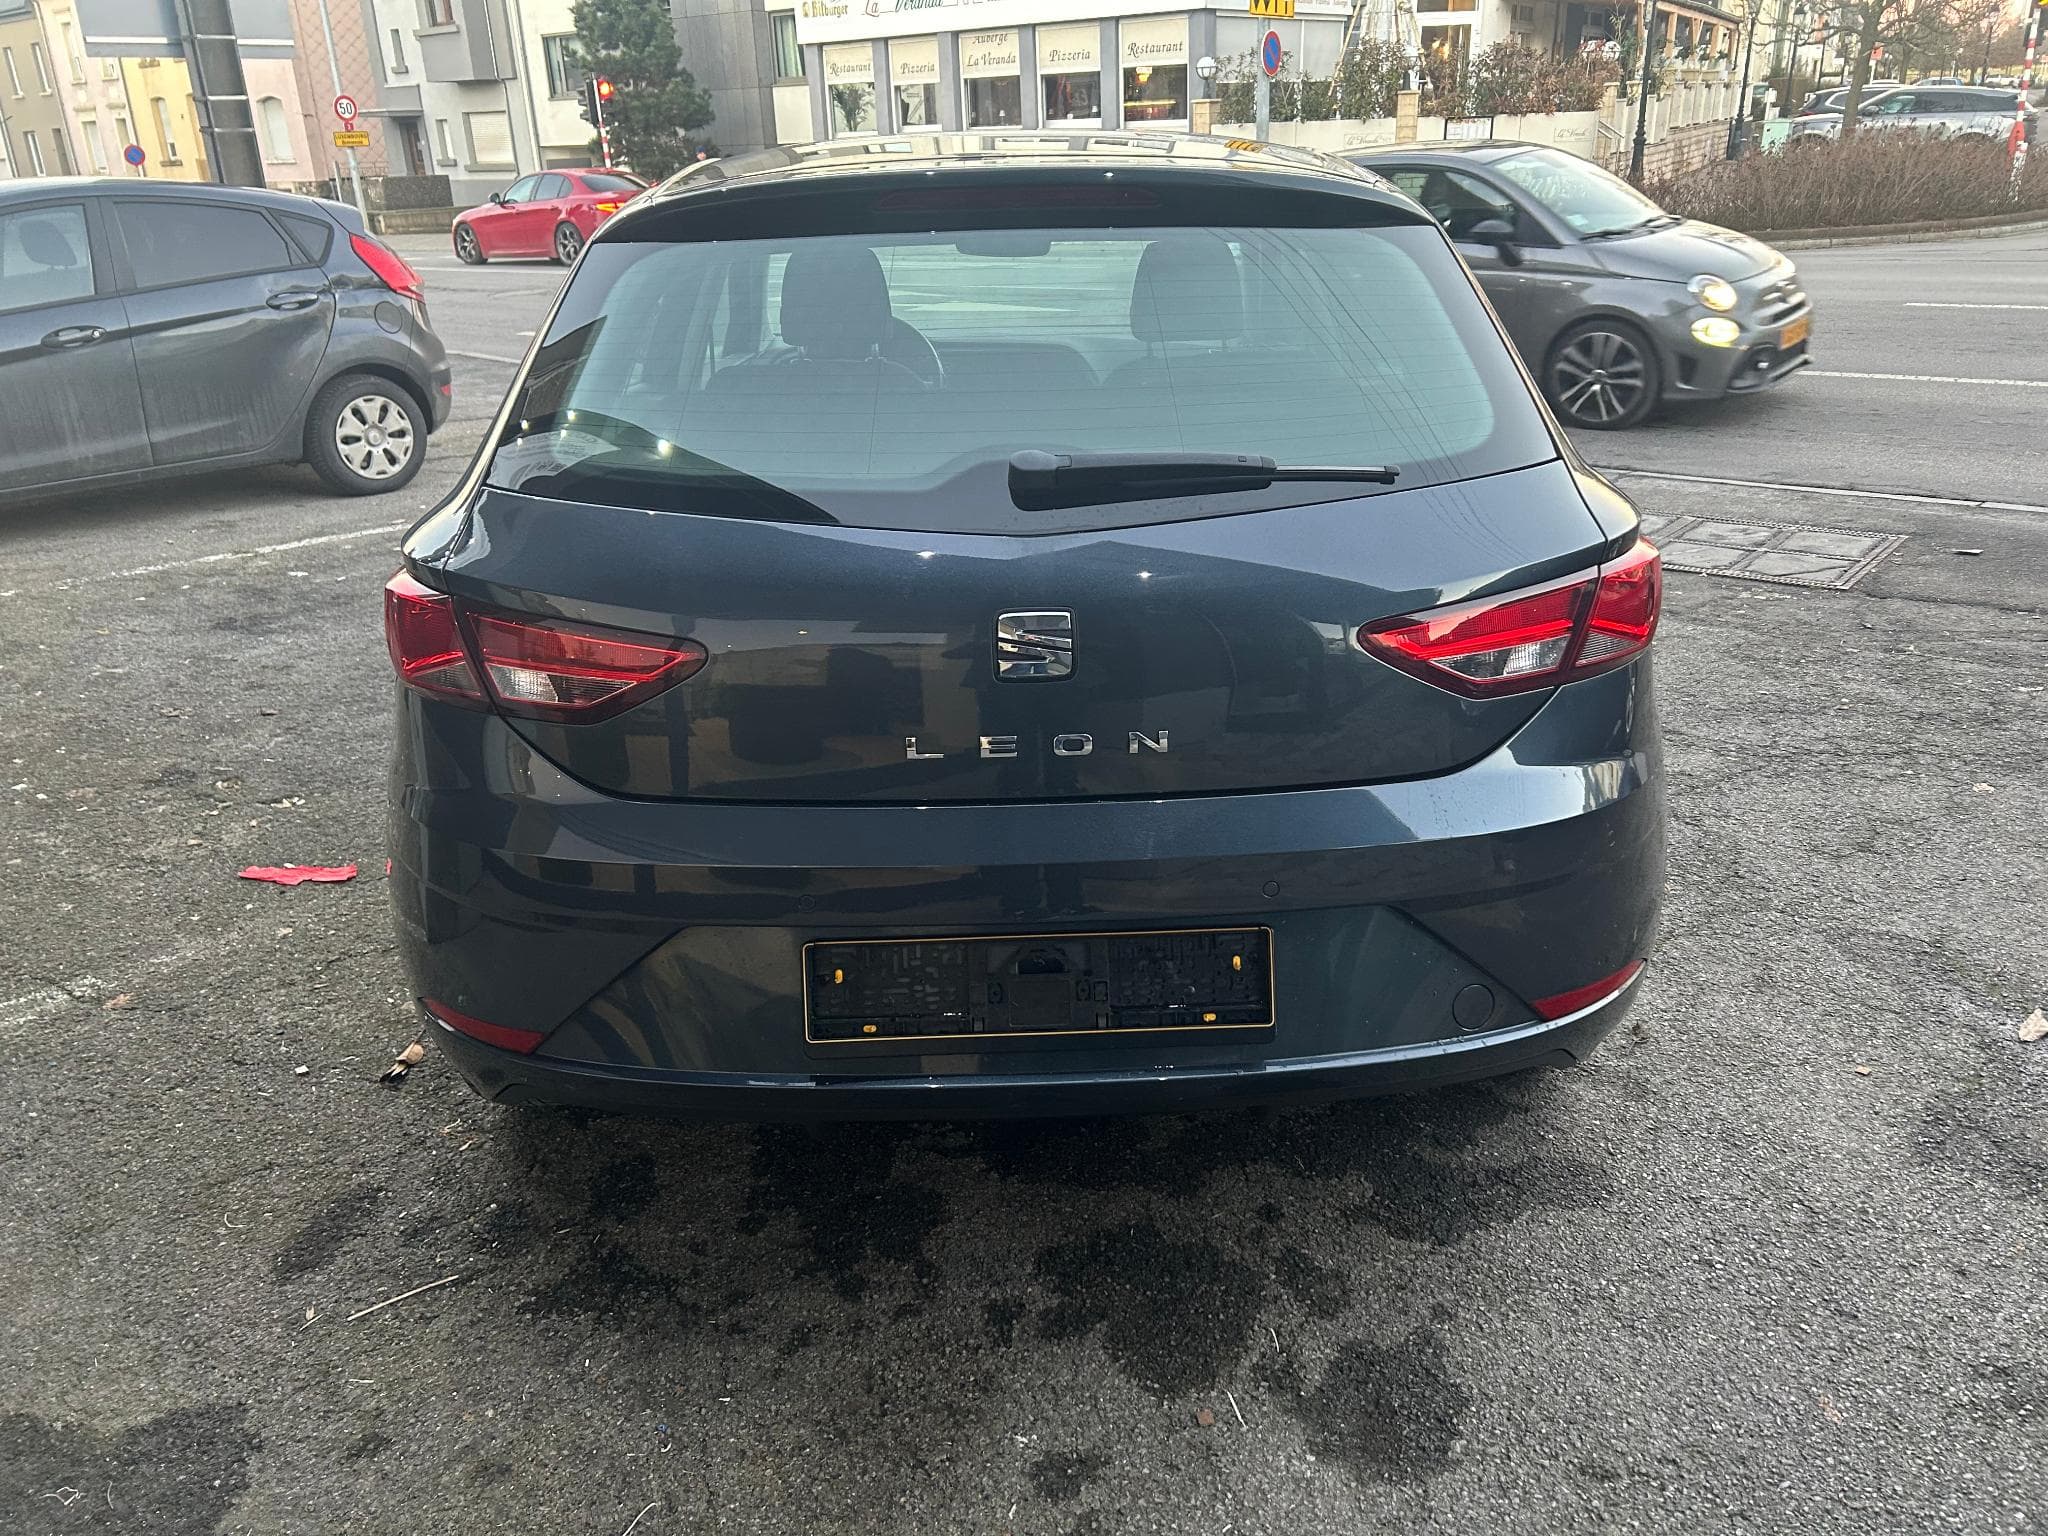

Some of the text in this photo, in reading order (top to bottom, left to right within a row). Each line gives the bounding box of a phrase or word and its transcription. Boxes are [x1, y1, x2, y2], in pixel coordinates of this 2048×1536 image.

[972, 33, 1008, 46] Auberge
[1049, 49, 1091, 62] Pizzeria
[1127, 41, 1183, 58] Restaurant
[967, 51, 1017, 67] La Veranda
[829, 62, 871, 76] Restaurant
[900, 62, 935, 74] Pizzeria
[338, 102, 353, 115] 50
[905, 730, 1169, 760] LEON
